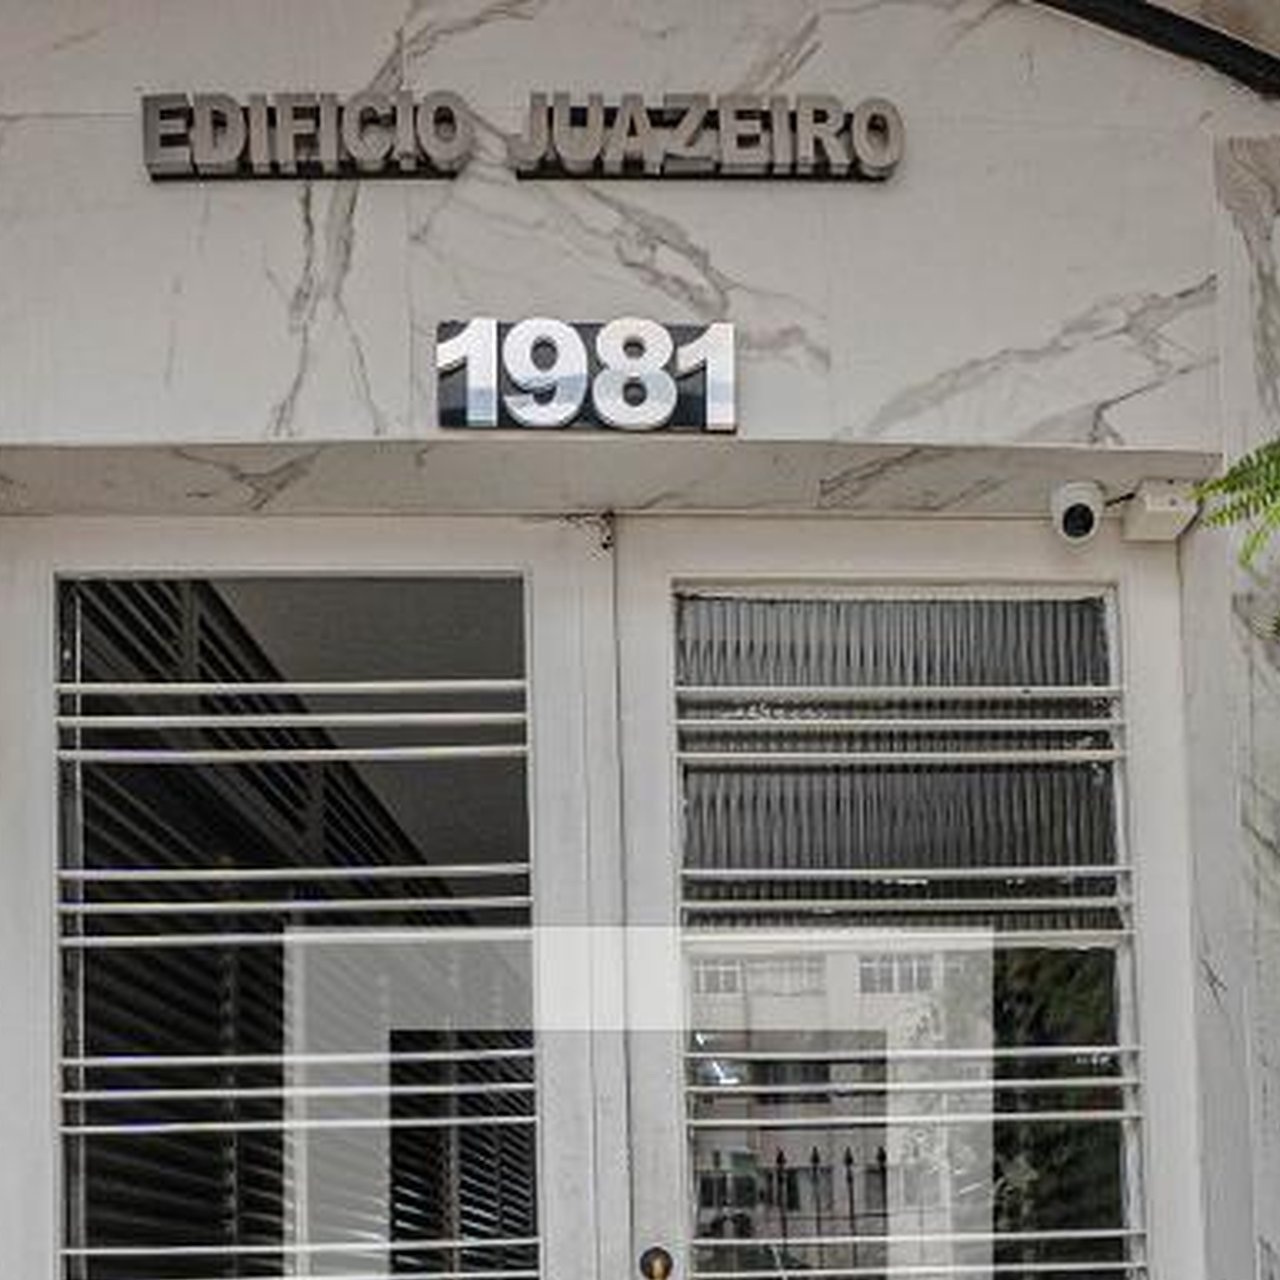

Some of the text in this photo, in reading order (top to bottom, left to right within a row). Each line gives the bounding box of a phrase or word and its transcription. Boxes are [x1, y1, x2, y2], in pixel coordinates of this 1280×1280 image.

[142, 92, 904, 177] EDIFICIO JUAZEIRO
[436, 318, 737, 430] 1981
